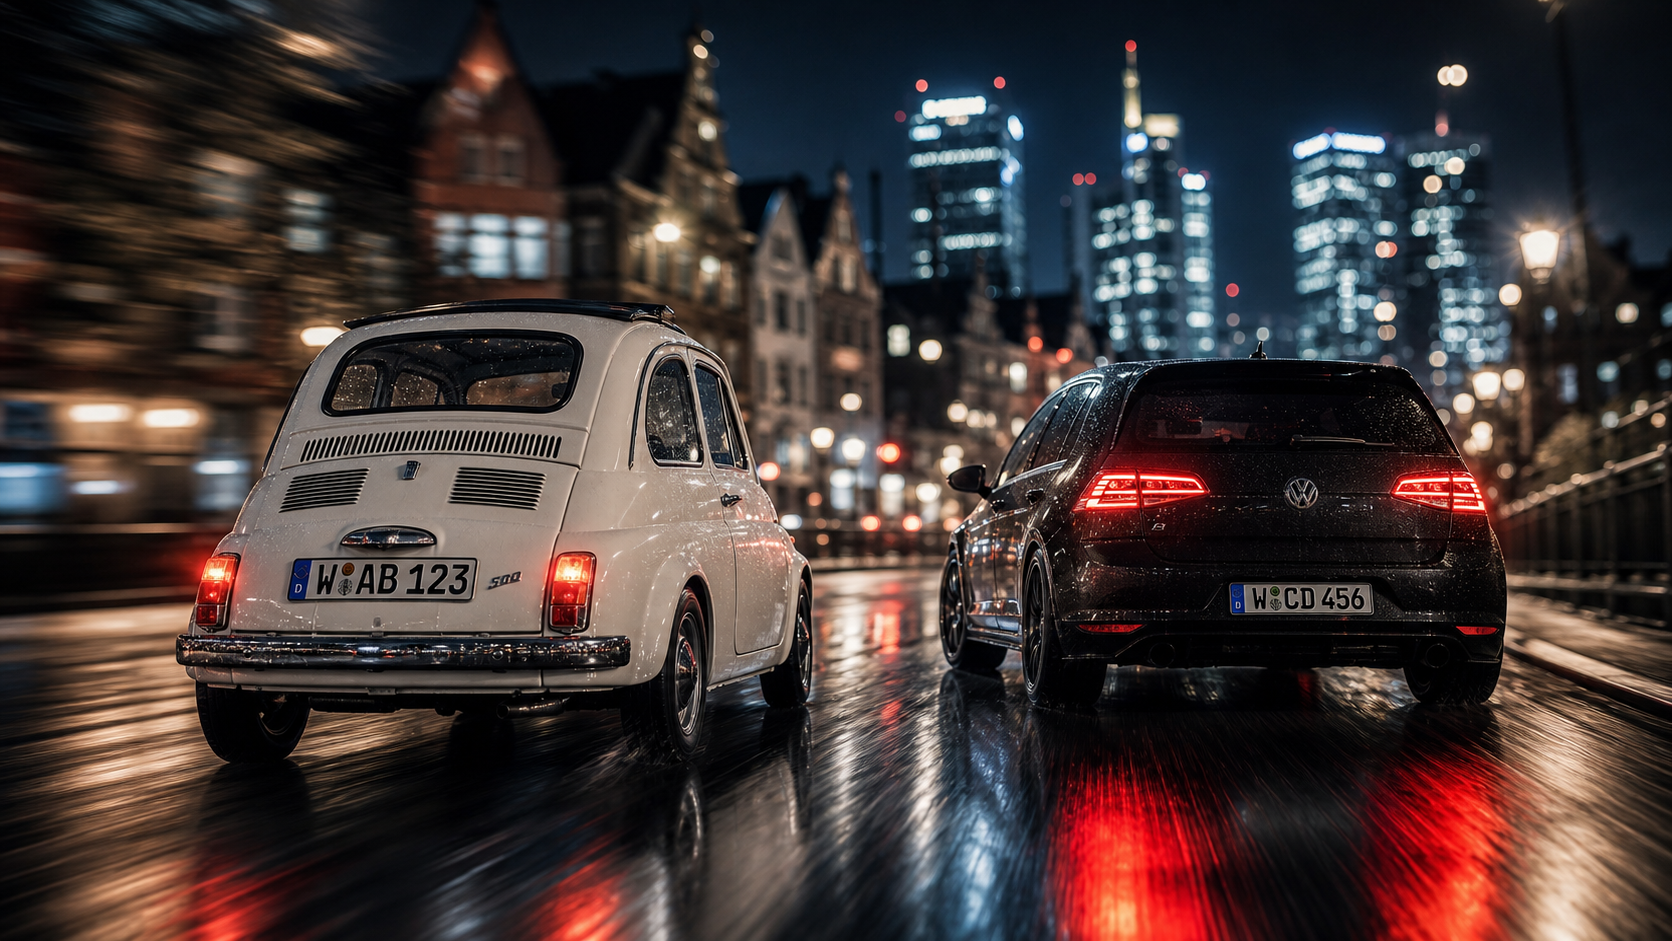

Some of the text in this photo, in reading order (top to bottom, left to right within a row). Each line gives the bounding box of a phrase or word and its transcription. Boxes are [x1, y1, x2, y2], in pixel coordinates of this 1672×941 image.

[1287, 478, 1318, 508] VW
[294, 584, 303, 594] D
[316, 564, 470, 595] W AB 123
[487, 571, 522, 590] 500
[1235, 601, 1242, 609] D
[1252, 587, 1365, 610] W CD 456
